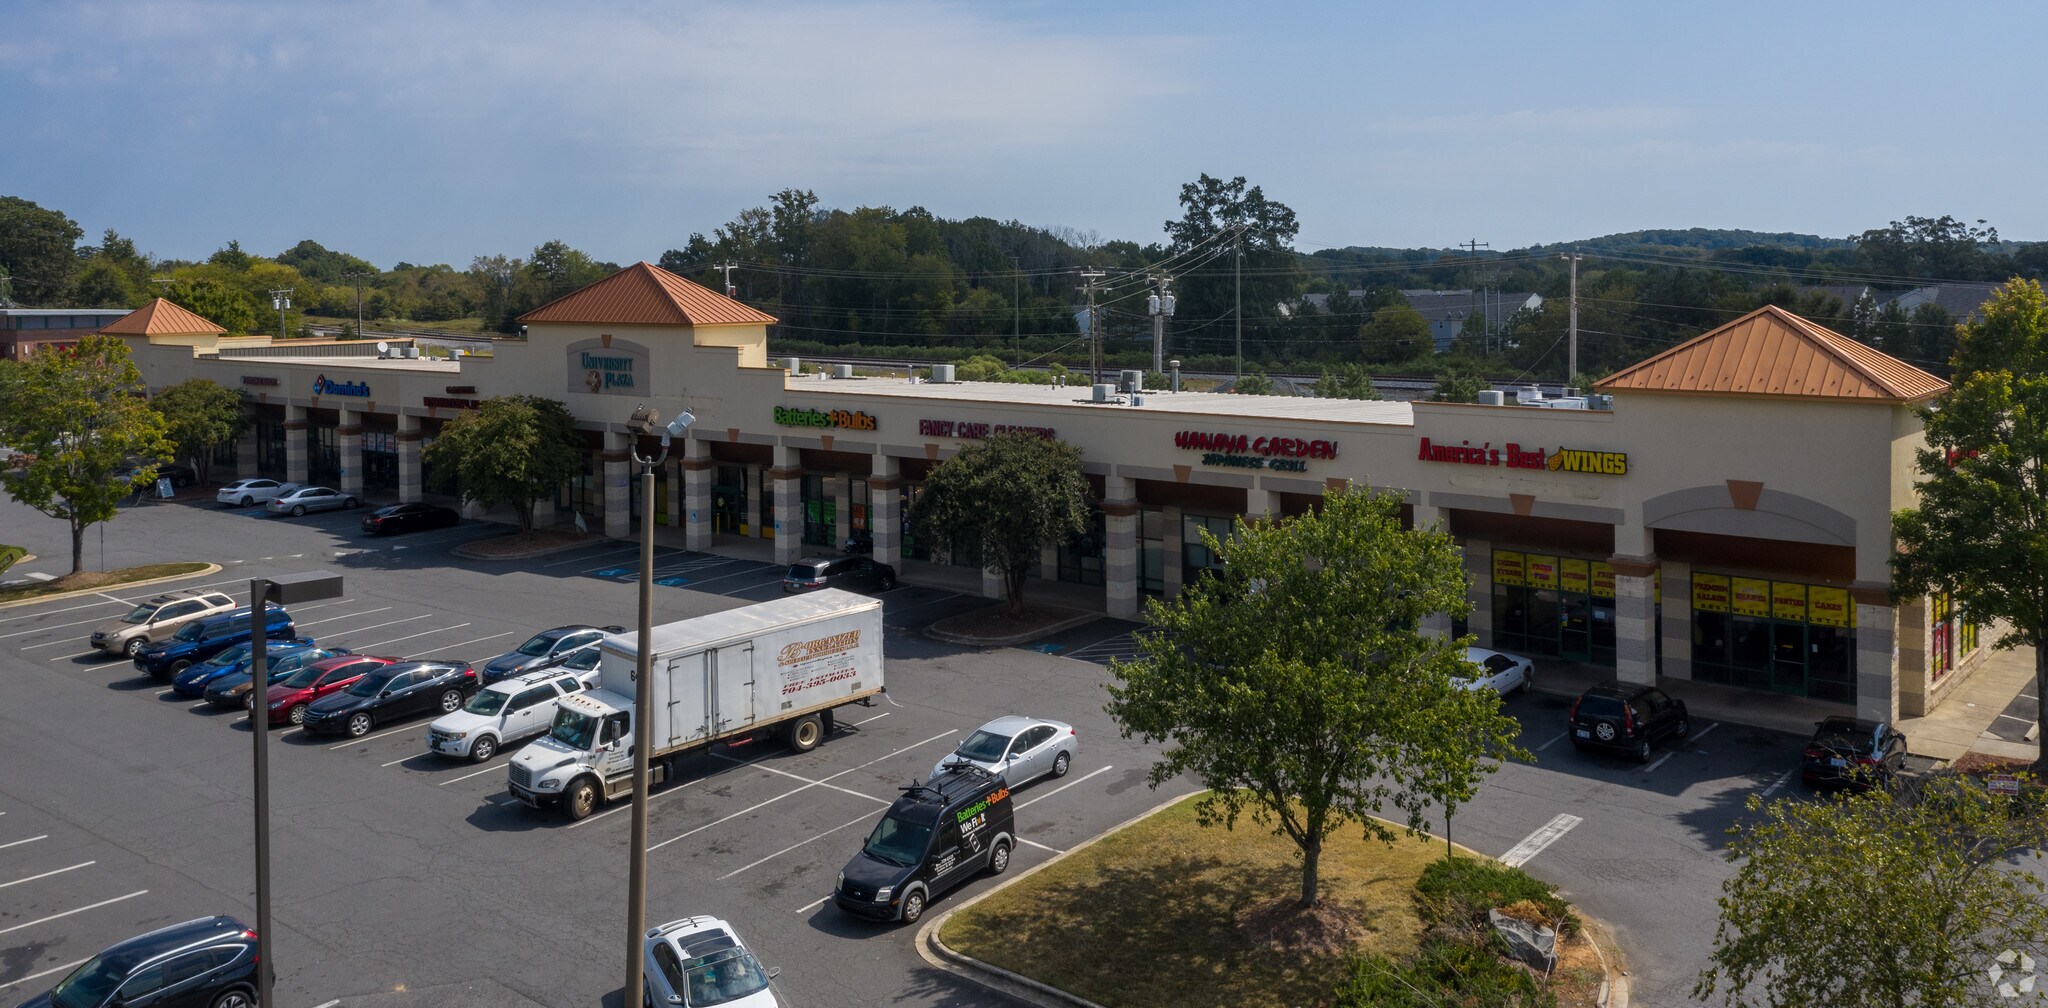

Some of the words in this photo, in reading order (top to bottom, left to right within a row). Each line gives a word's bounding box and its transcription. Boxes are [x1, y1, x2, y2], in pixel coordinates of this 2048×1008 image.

[325, 380, 370, 397] Domino's
[604, 372, 634, 389] PLAZA
[919, 419, 955, 437] FANCY
[957, 422, 989, 440] CARE
[1174, 431, 1248, 454] HANAYA
[1252, 436, 1338, 460] GARDEN
[1202, 453, 1265, 469] JAPANESE
[1269, 458, 1307, 472] GRILL
[1418, 437, 1499, 466] America's
[1506, 443, 1545, 470] Best
[1561, 449, 1627, 475] WINGS
[784, 680, 806, 688] FREE
[960, 822, 972, 834] We
